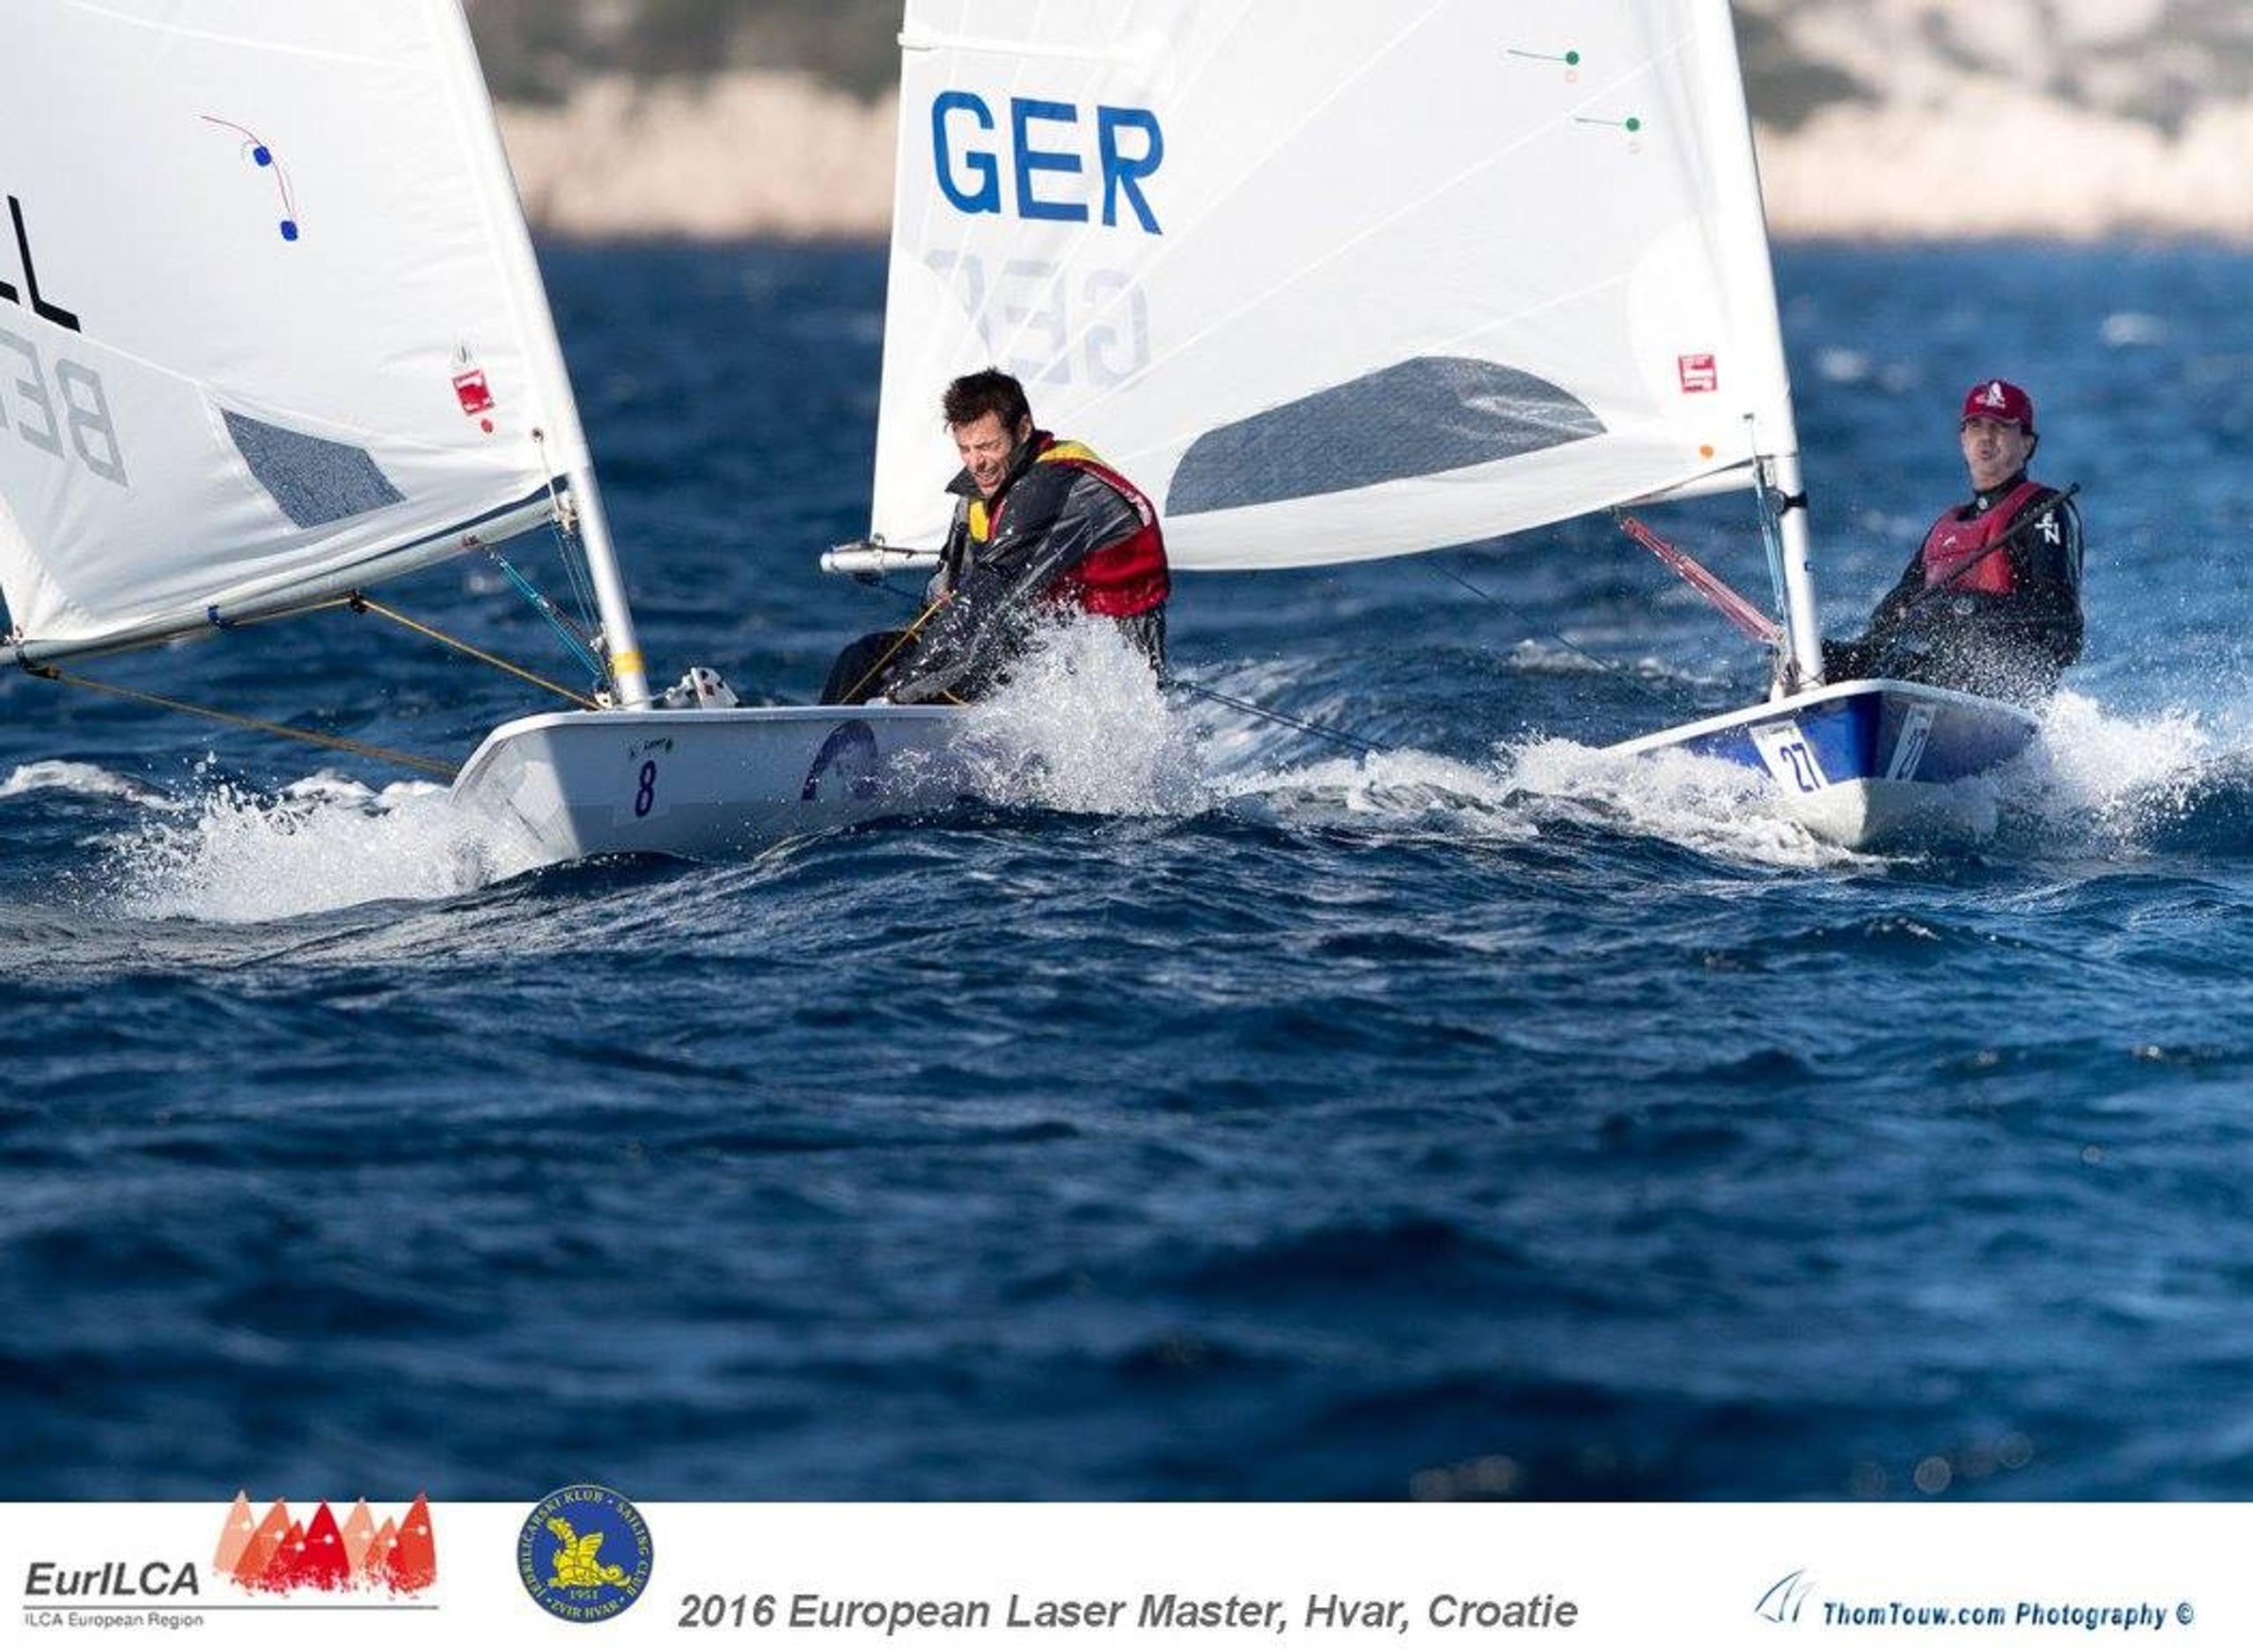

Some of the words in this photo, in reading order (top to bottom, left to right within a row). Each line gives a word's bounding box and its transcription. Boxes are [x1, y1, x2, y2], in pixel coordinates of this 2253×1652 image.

[932, 91, 1163, 235] GER
[635, 760, 657, 818] 8
[1780, 743, 1820, 793] 27
